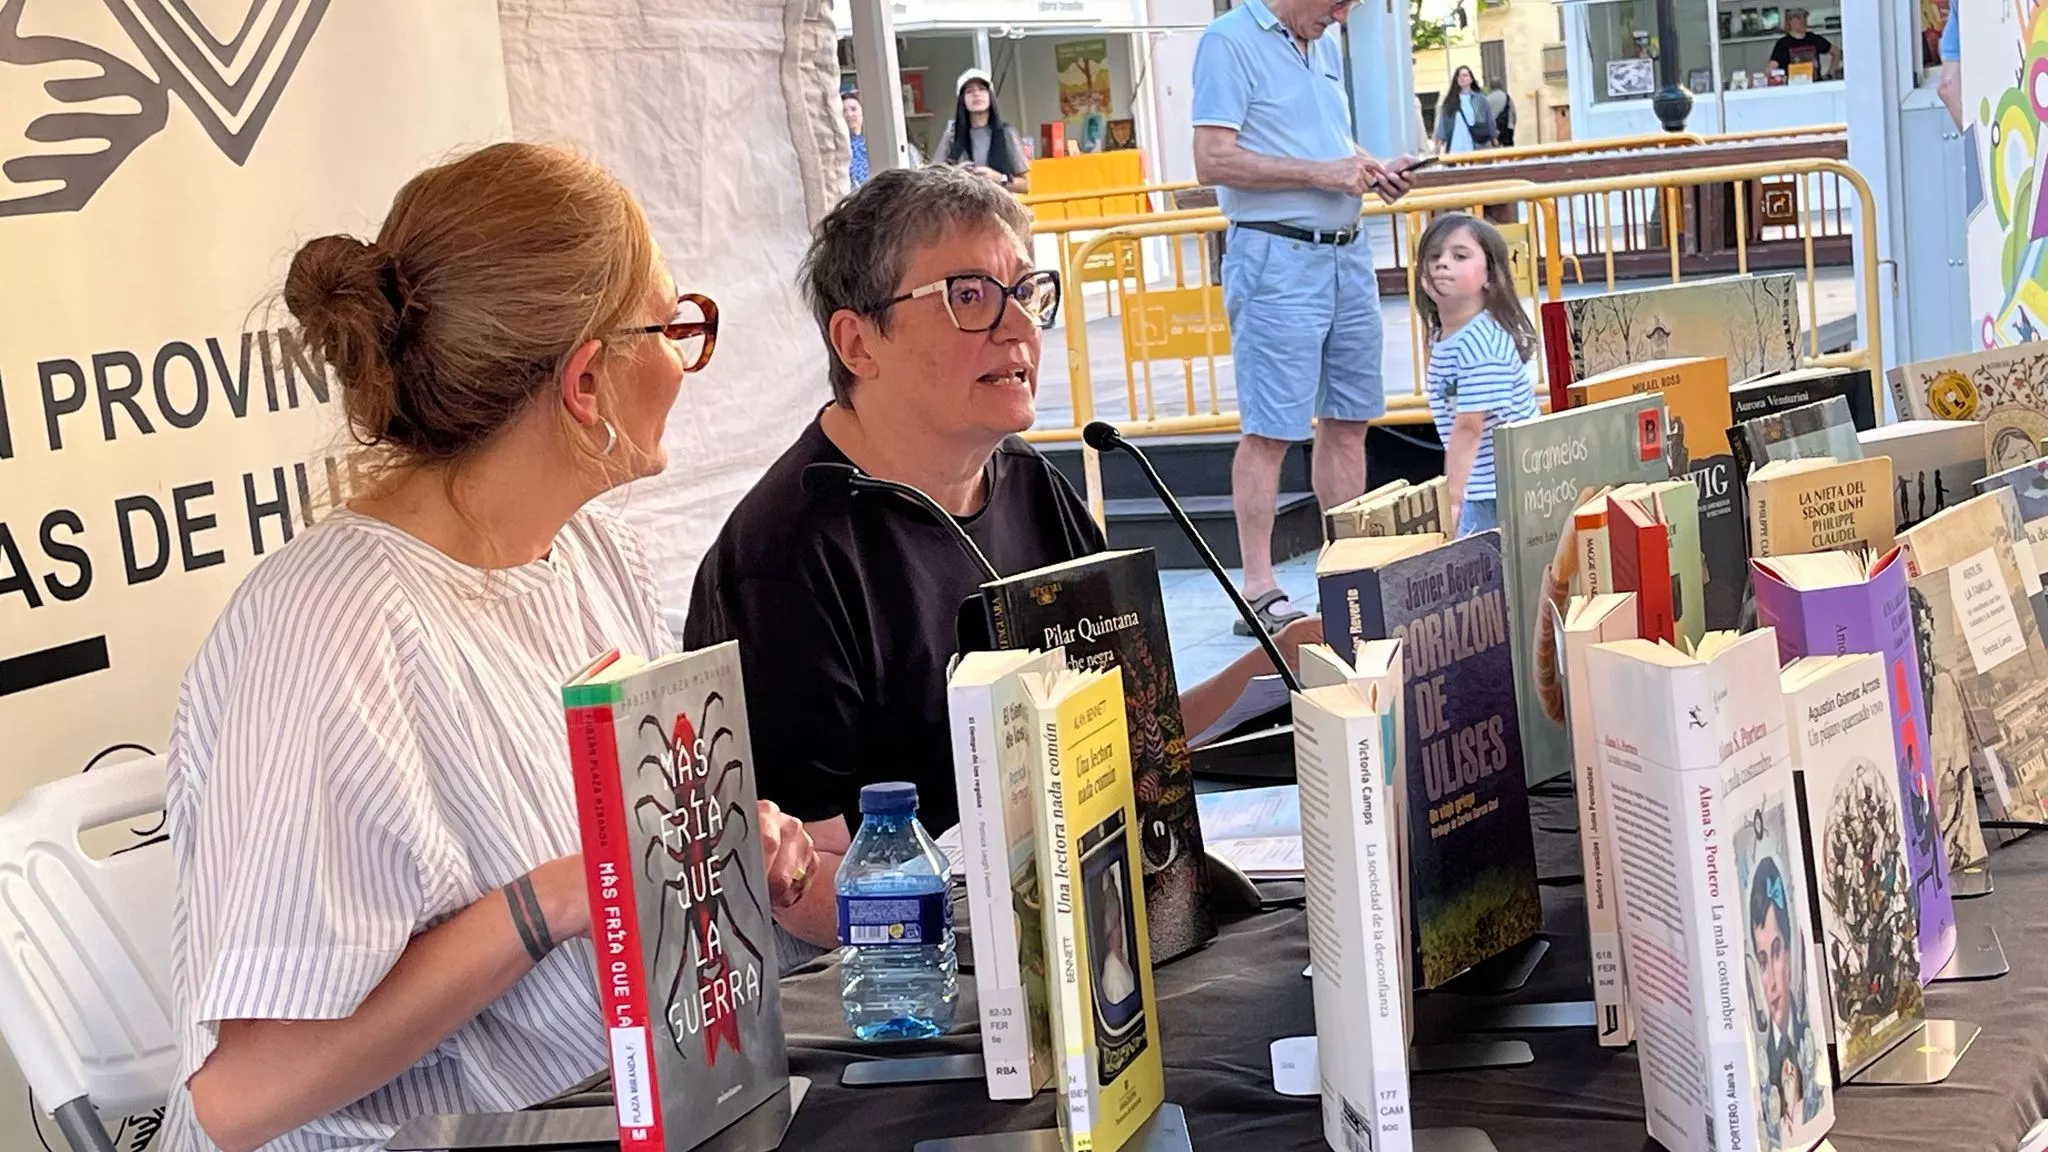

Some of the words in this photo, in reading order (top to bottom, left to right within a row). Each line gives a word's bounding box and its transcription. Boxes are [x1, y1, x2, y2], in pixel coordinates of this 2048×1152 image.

[37, 327, 330, 451] PROVIN
[1632, 379, 1660, 394] MIKAEL
[1661, 374, 1681, 387] ROSS
[1736, 401, 1766, 413] Aurora
[1767, 390, 1809, 406] Venturini
[1522, 435, 1588, 475] Caramelos
[1524, 478, 1578, 518] mágicos
[1799, 493, 1812, 505] LA
[1814, 485, 1844, 503] NIETA
[1847, 481, 1865, 494] DEL
[115, 481, 225, 586] DE
[1812, 513, 1855, 532] PHILIPPE
[1812, 527, 1856, 548] CLAUDEL
[1405, 571, 1444, 611] Javier
[1446, 552, 1493, 595] Reverte
[1347, 588, 1363, 634] Reverte
[1043, 624, 1076, 648] Pilar
[1078, 612, 1139, 643] Quintana
[1392, 586, 1505, 684] CORAZÓN
[1835, 624, 1848, 656] Amo
[1066, 654, 1085, 670] che
[1086, 650, 1115, 669] negra
[1414, 675, 1450, 740] DE
[660, 737, 708, 790] MÁS
[1042, 723, 1060, 777] común
[1358, 739, 1371, 784] Victoria
[1422, 714, 1507, 802] ULISES
[1047, 781, 1063, 819] nada
[1362, 787, 1373, 825] Camps
[1699, 785, 1713, 826] Alana
[660, 789, 723, 854] FRÍA
[1703, 829, 1716, 842] S.
[1053, 823, 1069, 879] lectora
[1366, 844, 1376, 857] La
[599, 862, 618, 899] MÁS
[677, 855, 723, 910] QUE
[1368, 859, 1382, 911] sociedad
[1705, 844, 1720, 898] Portero
[1057, 883, 1072, 915] Una
[1711, 905, 1724, 921] La
[604, 906, 628, 955] FRÍA
[1373, 913, 1384, 928] de
[1374, 930, 1384, 941] la
[690, 920, 722, 967] LA
[1062, 936, 1076, 983] BENNETT
[1713, 925, 1728, 957] mala
[611, 961, 632, 997] QUE
[1375, 942, 1389, 1018] desconfianza
[1598, 964, 1616, 973] FER
[668, 963, 760, 1043] GUERRA
[989, 1008, 1012, 1017] 82-33
[1718, 961, 1736, 1031] costumbre
[615, 1004, 634, 1028] LA
[990, 1022, 1008, 1030] FER
[996, 1067, 1018, 1075] RBA
[1726, 1073, 1737, 1099] Alana
[631, 1095, 641, 1123] PLAZA
[1380, 1090, 1397, 1100] 177
[1380, 1106, 1404, 1116] CAM
